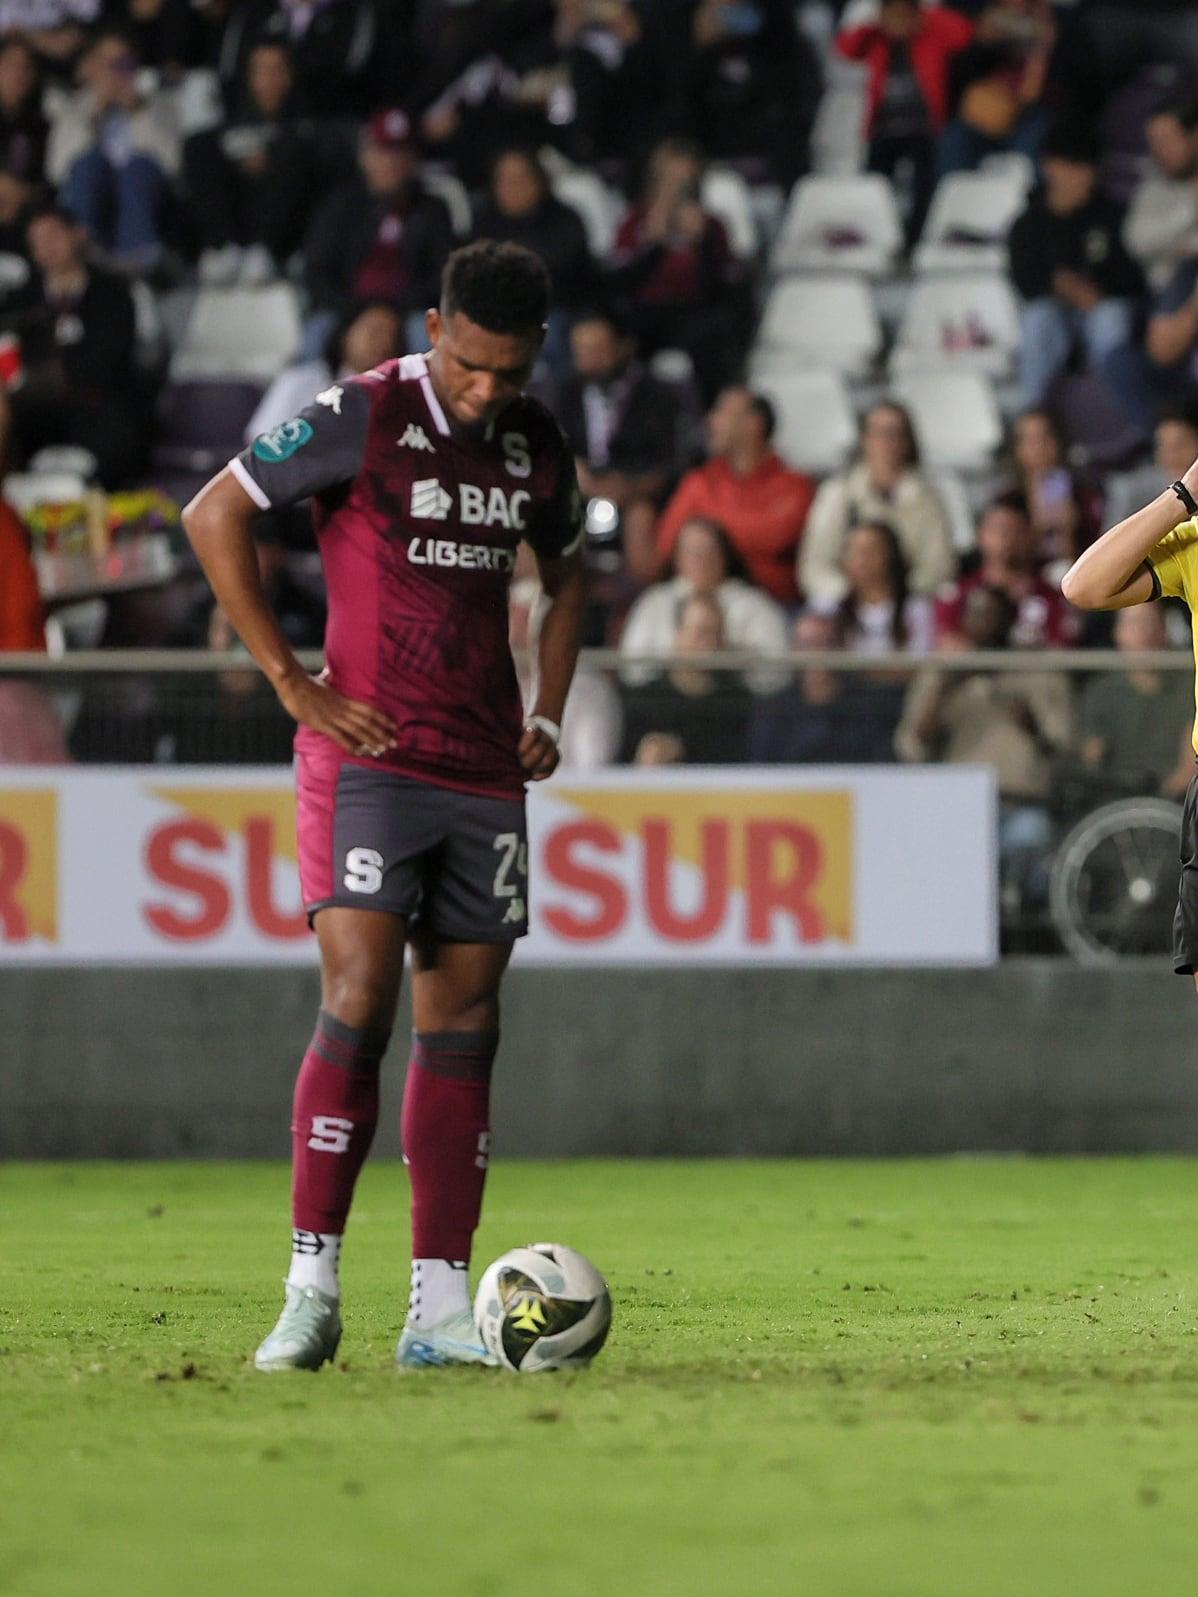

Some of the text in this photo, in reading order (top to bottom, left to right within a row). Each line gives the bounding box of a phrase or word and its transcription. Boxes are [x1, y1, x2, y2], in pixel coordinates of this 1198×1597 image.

[502, 431, 532, 479] S
[458, 483, 531, 531] BAC
[343, 847, 385, 895] S
[541, 815, 827, 943] SUR
[307, 1115, 355, 1154] S
